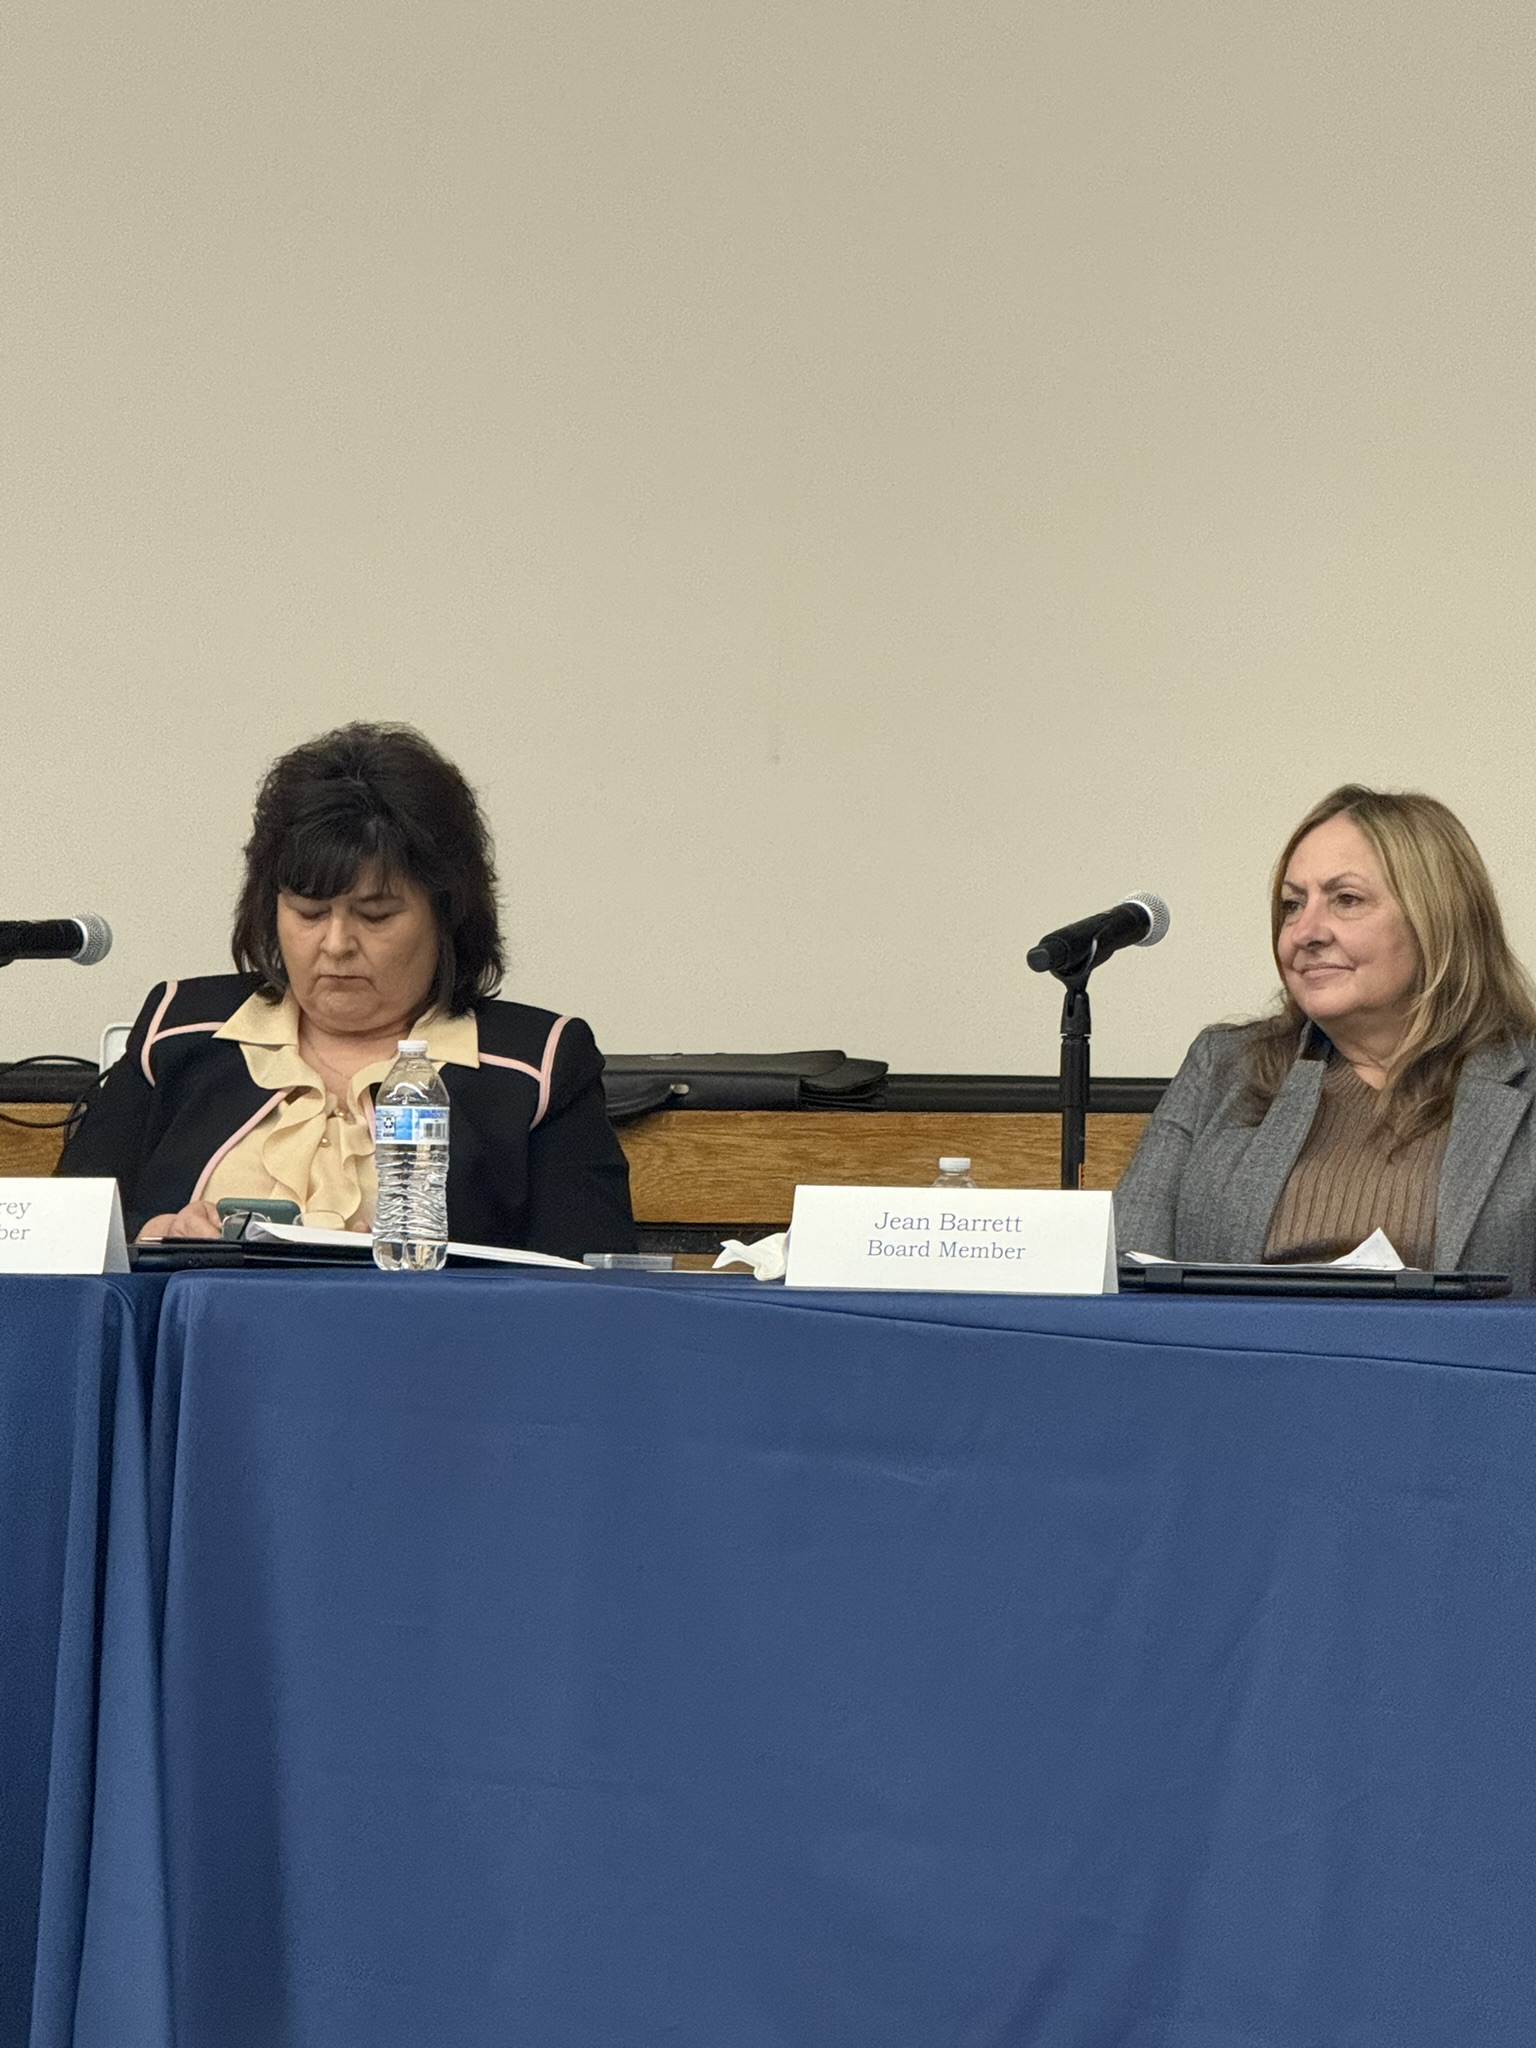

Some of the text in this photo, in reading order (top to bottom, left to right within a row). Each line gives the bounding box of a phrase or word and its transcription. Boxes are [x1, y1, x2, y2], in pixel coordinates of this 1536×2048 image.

[874, 1211, 1023, 1233] Jean Barrett
[866, 1238, 1027, 1260] Board Member
